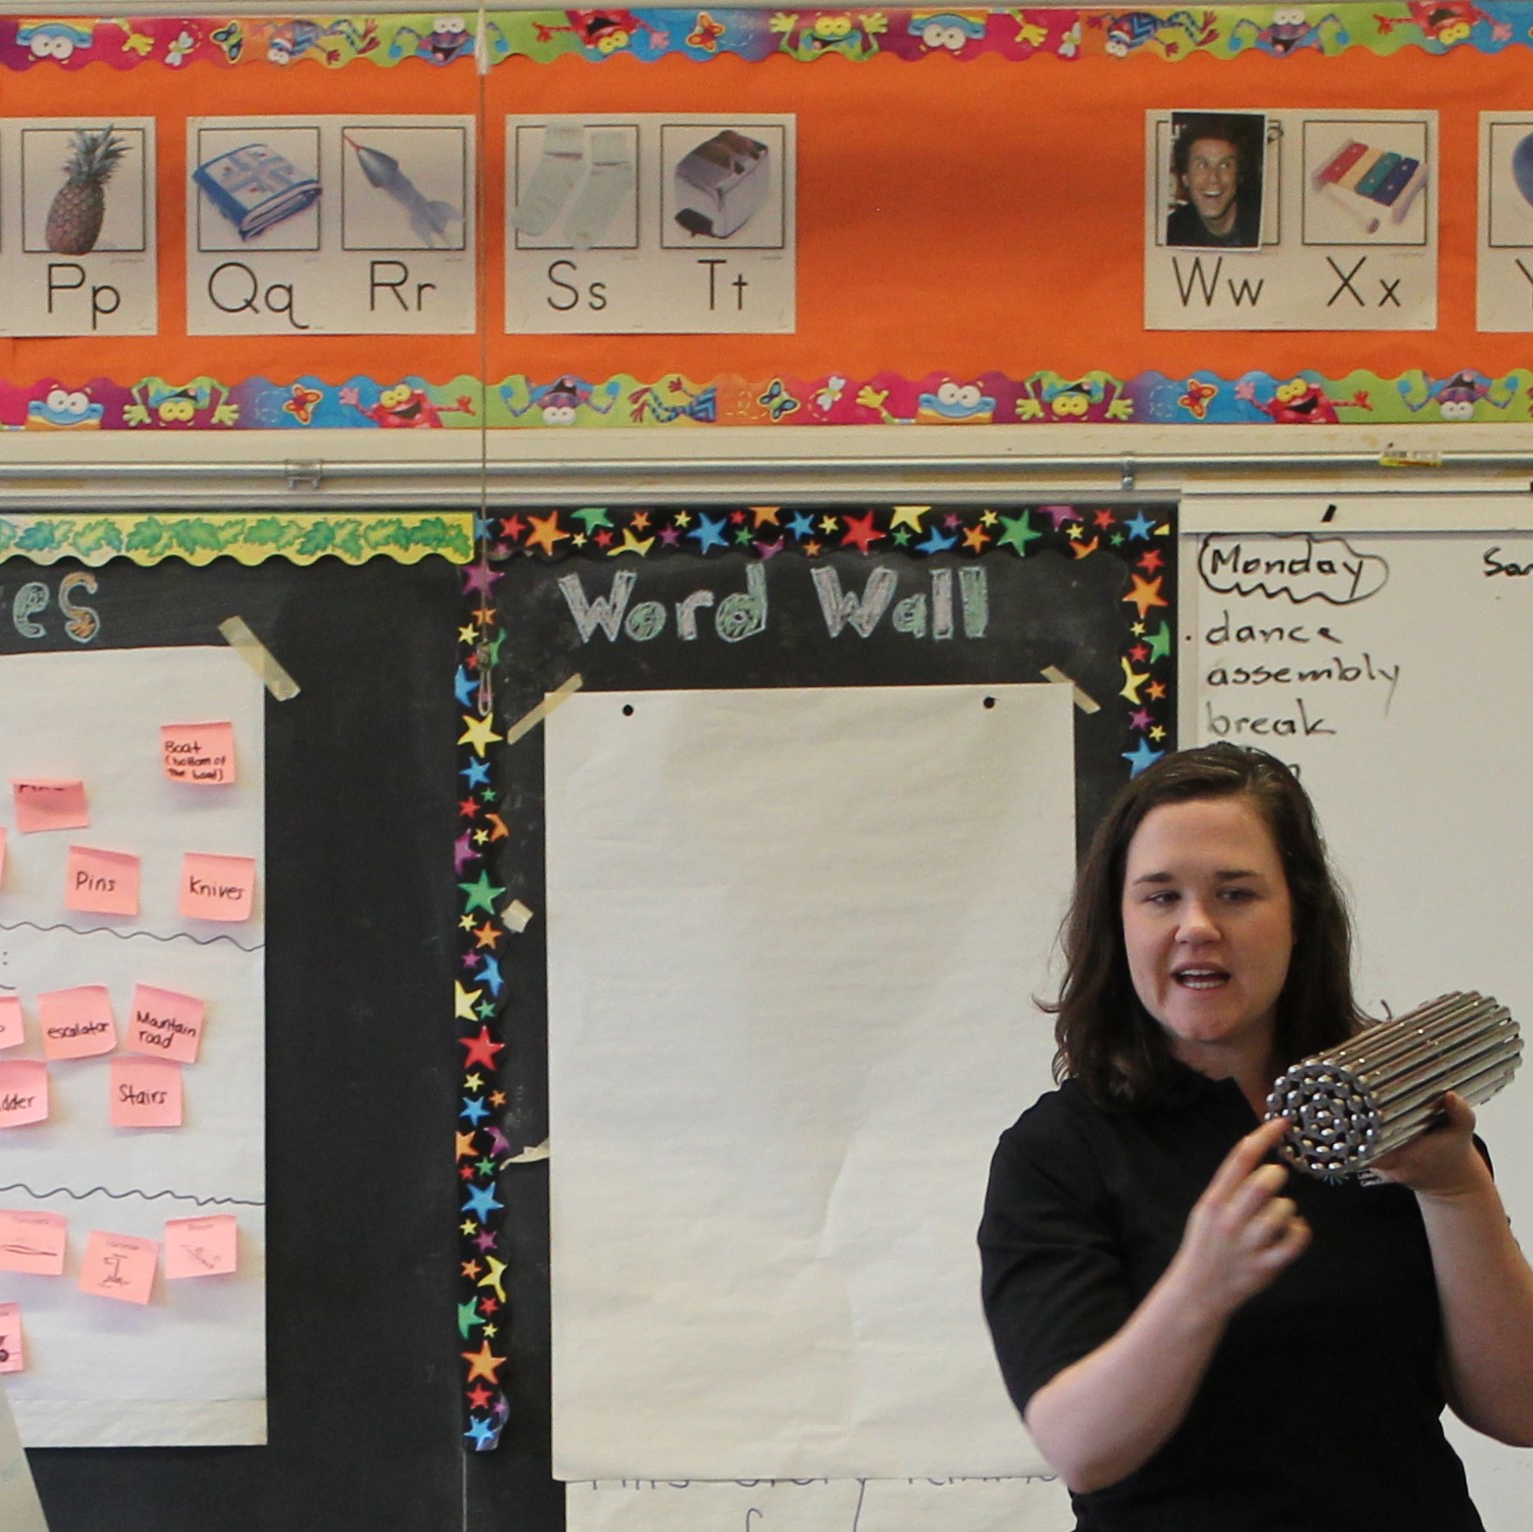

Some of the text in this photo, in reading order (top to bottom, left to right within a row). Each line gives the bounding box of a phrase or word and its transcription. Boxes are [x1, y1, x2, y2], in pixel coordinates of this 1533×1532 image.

[47, 261, 122, 331] Pp
[207, 259, 437, 331] Qq Rr
[546, 258, 749, 312] Ss Tt
[1171, 255, 1401, 308] Ww Xx
[1209, 543, 1366, 599] Monday
[559, 562, 988, 644] Word Wall
[1204, 609, 1343, 647] dance
[1205, 652, 1401, 720] assembly
[1205, 697, 1337, 737] break
[164, 740, 202, 754] Boat
[75, 870, 117, 892] Pins
[189, 875, 244, 901] Knives
[46, 1021, 110, 1040] escalator
[138, 1028, 176, 1050] road
[118, 1083, 168, 1106] Stairs
